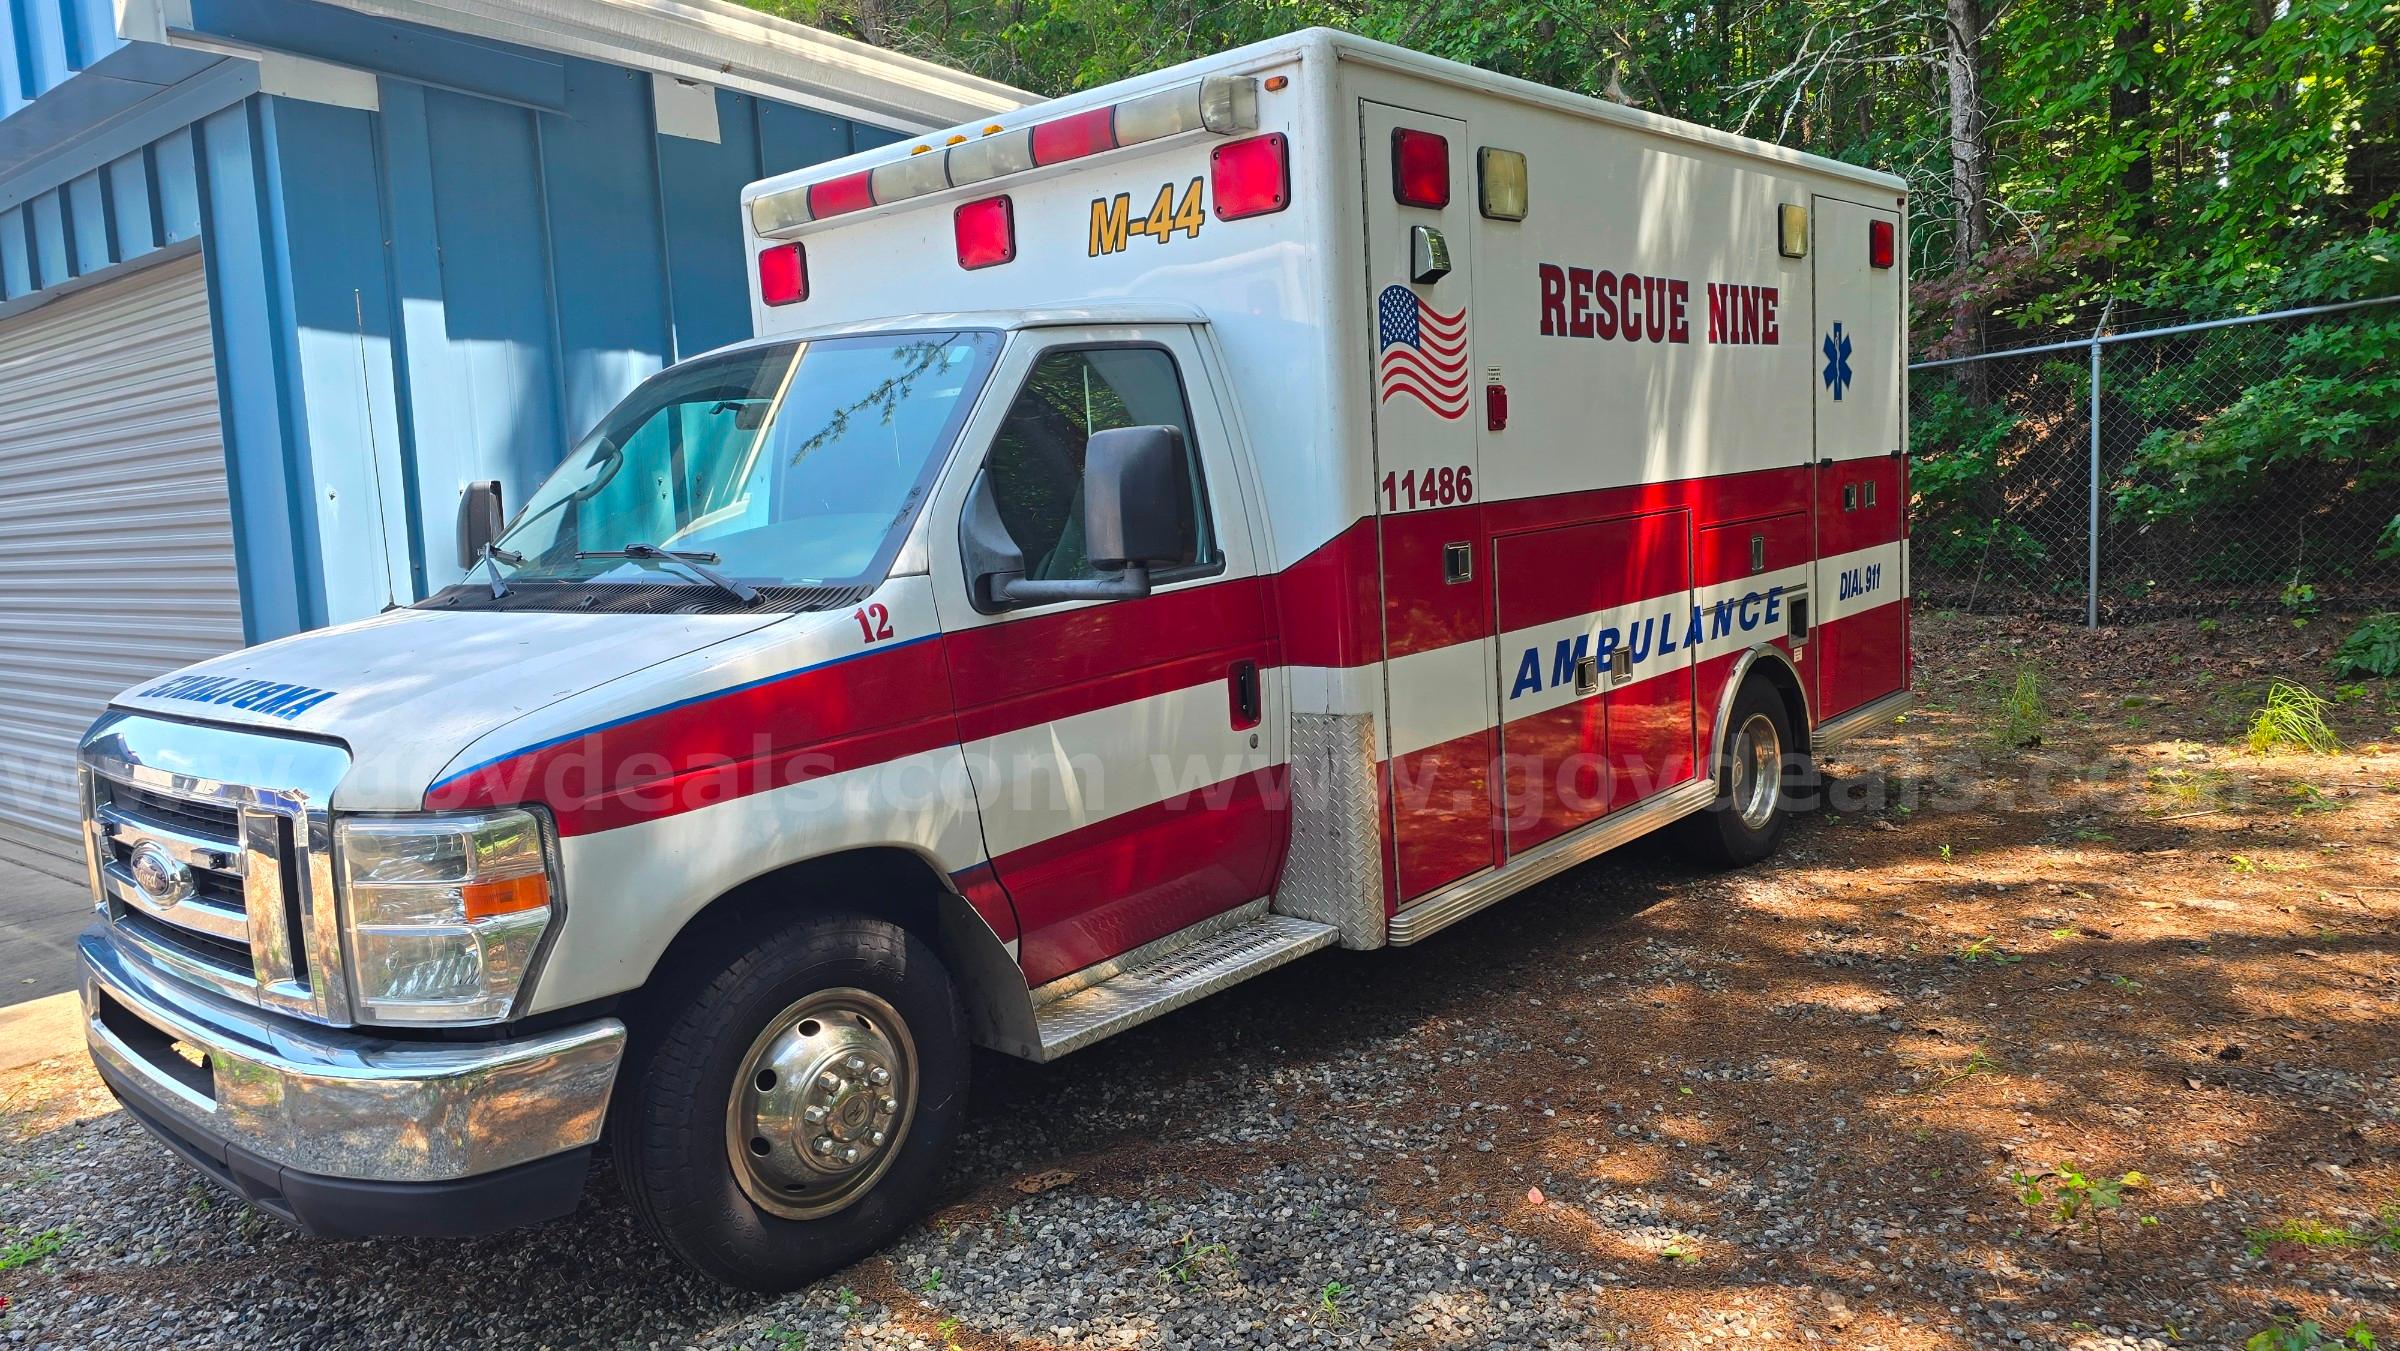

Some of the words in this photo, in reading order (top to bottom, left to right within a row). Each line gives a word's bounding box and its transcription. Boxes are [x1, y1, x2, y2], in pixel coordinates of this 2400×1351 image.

[1088, 175, 1206, 258] M-44
[1539, 263, 1690, 344] RESCUE
[1707, 282, 1780, 345] NINE
[1382, 465, 1473, 512] 11486
[1840, 567, 1863, 601] DIAL
[1866, 563, 1881, 592] 911
[853, 603, 894, 644] 12
[1509, 585, 1784, 700] AMBULANCE
